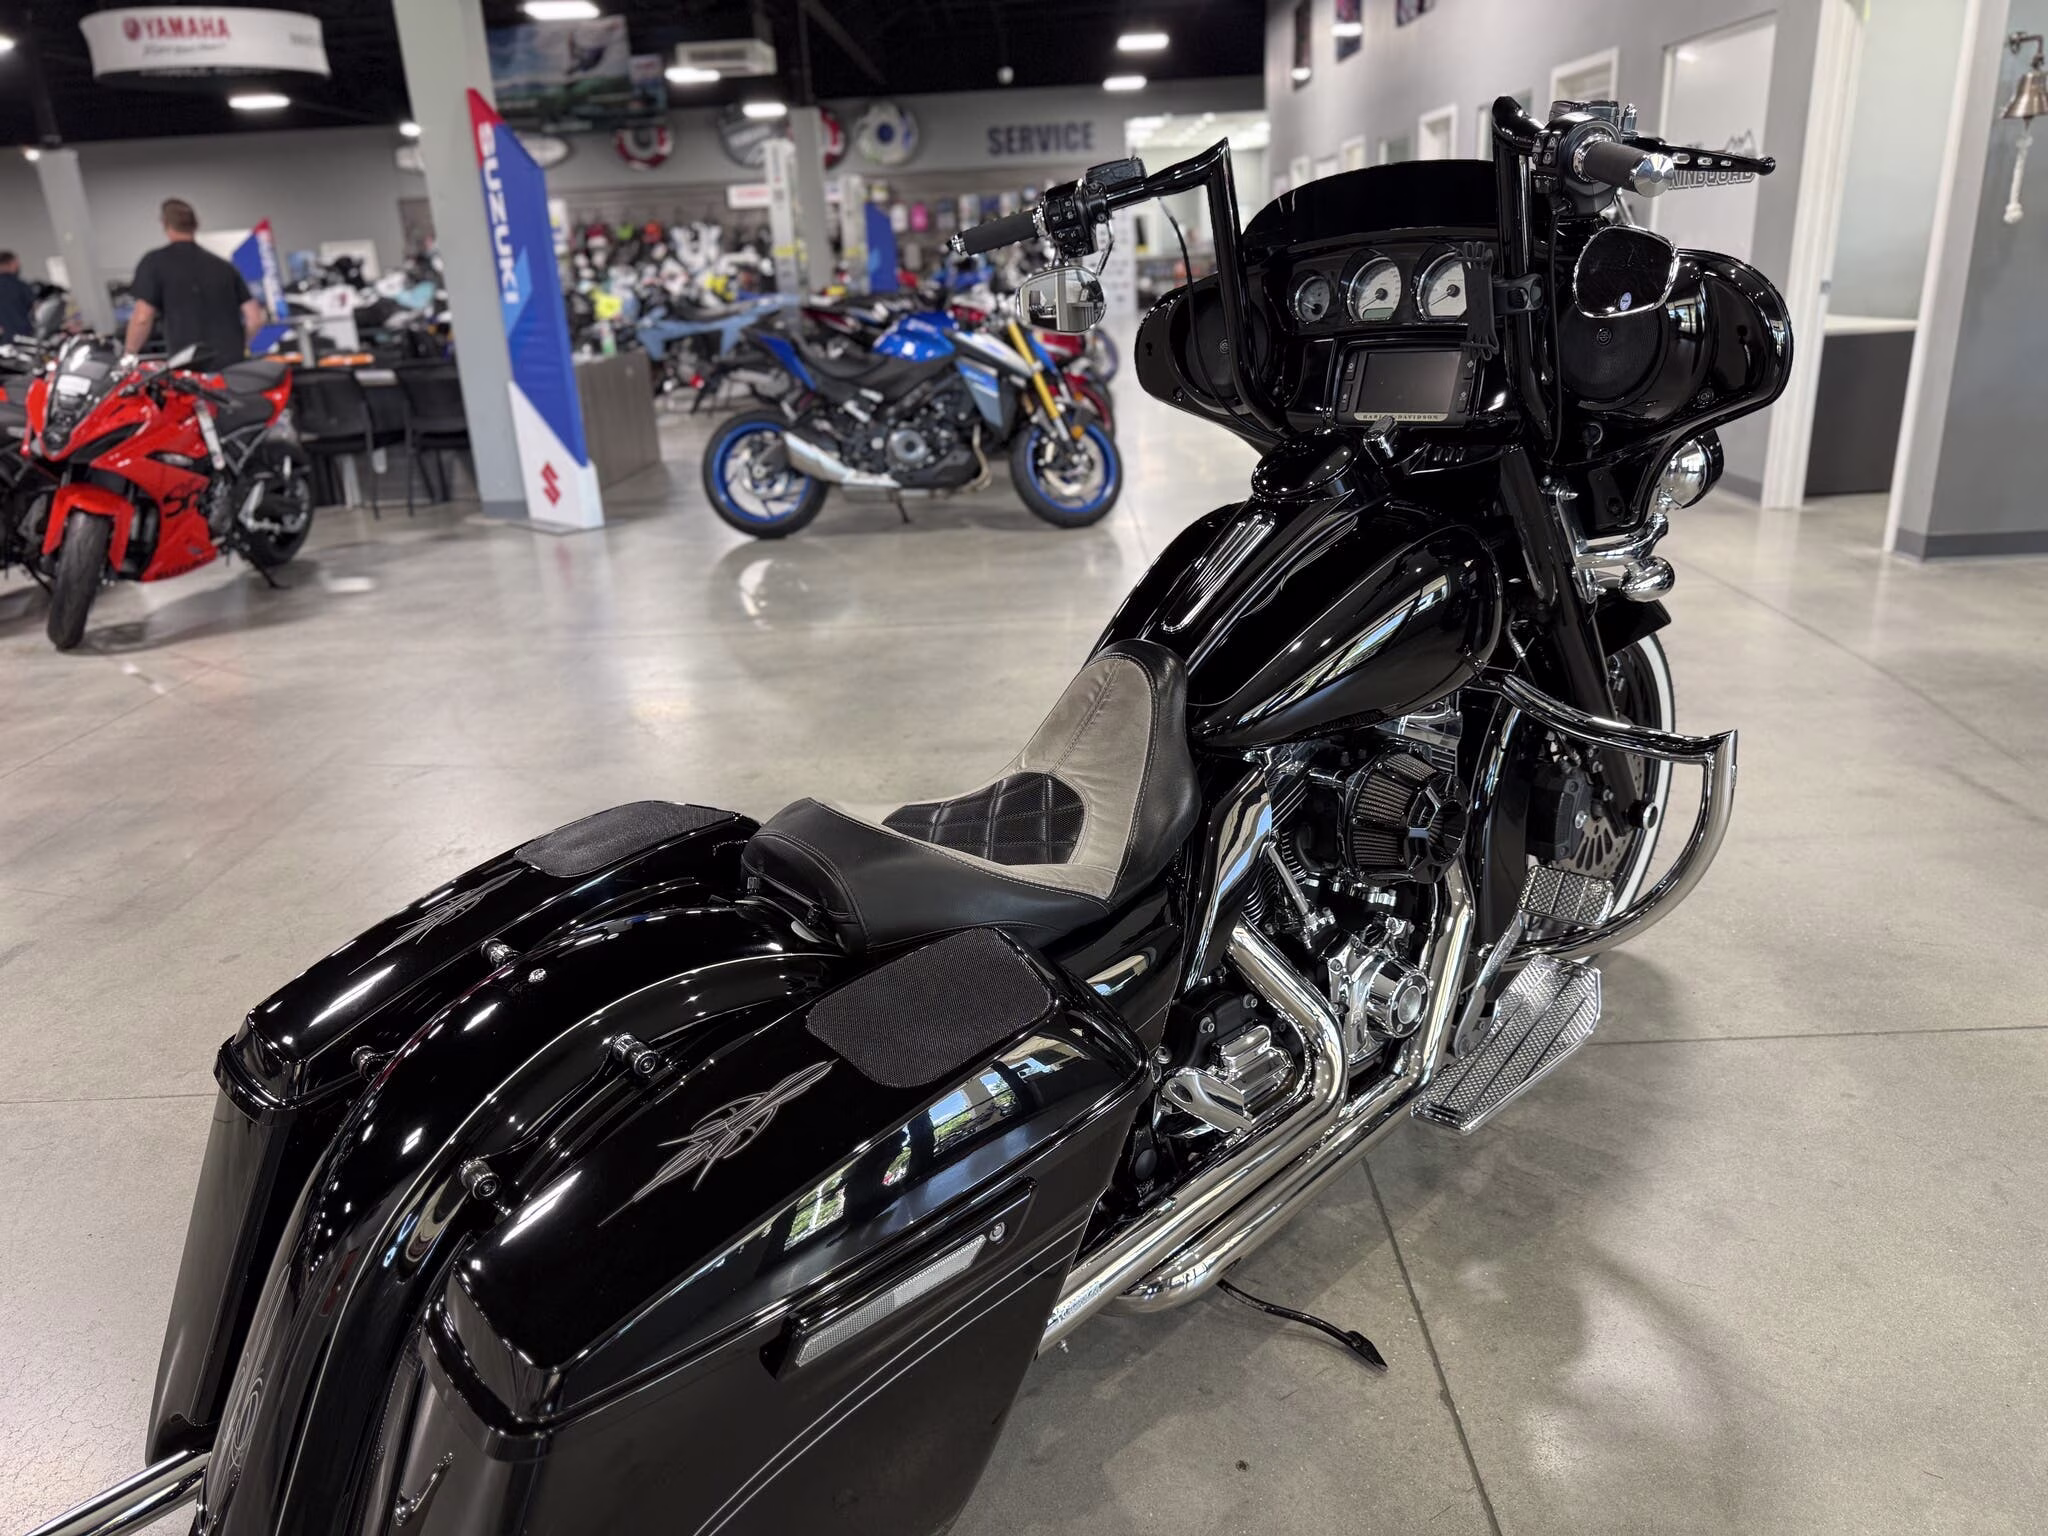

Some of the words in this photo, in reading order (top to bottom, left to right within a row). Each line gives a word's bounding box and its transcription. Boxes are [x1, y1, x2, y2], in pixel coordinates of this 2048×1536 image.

[143, 17, 231, 39] YAMAHA
[987, 120, 1094, 156] SERVICE
[478, 122, 519, 304] SUZUKI
